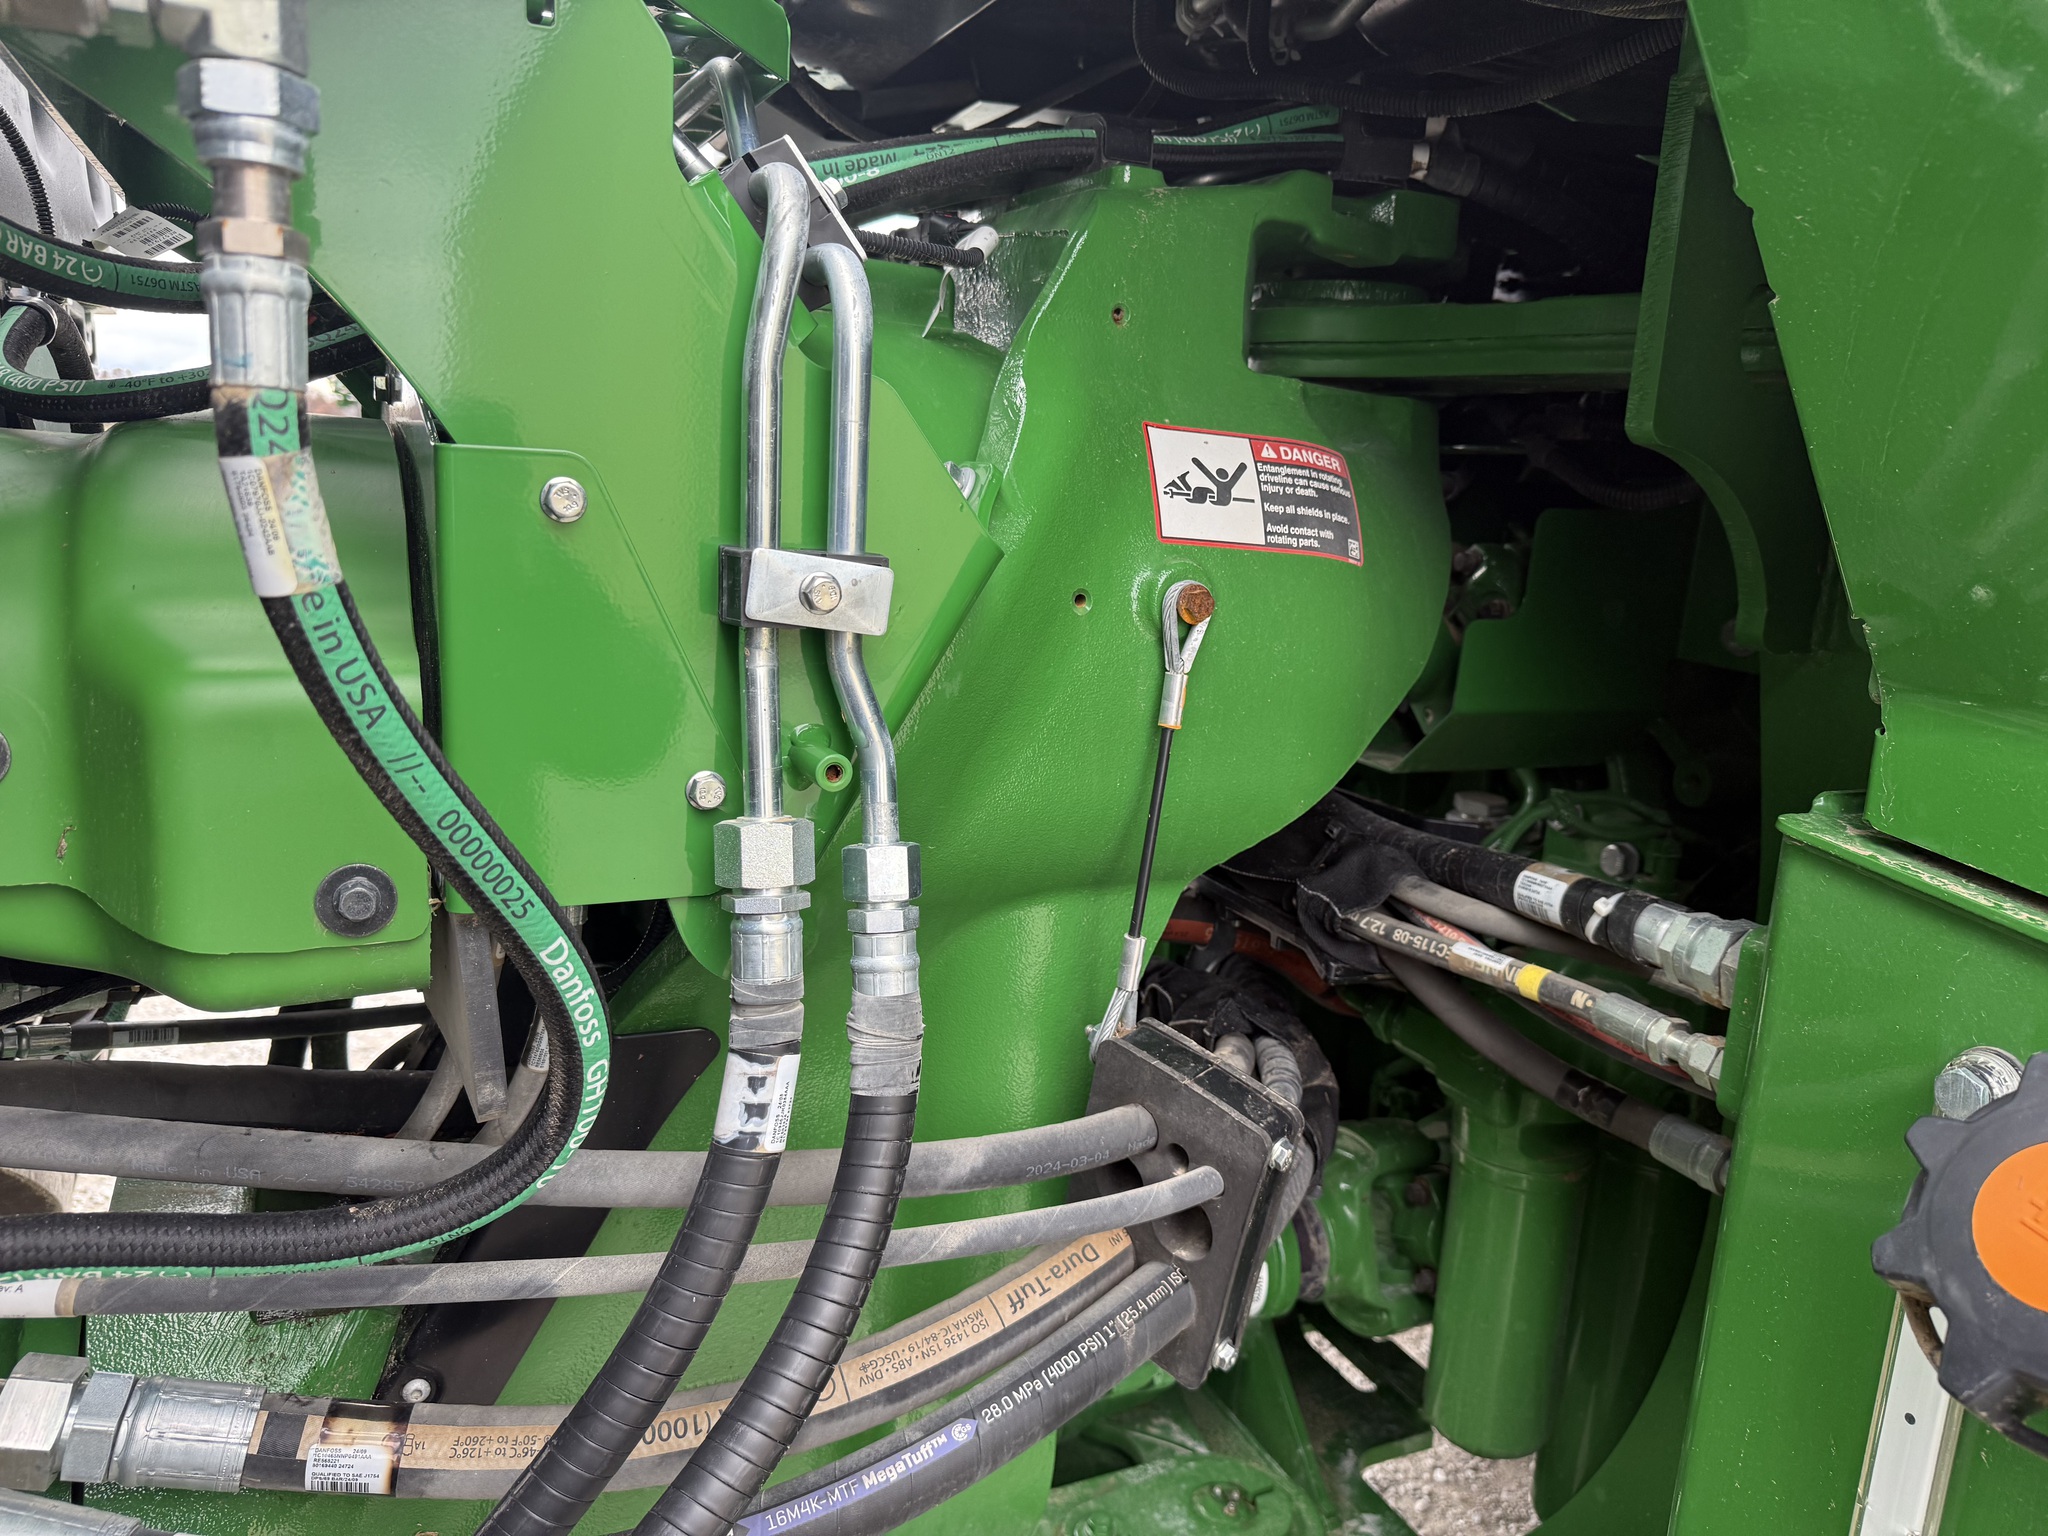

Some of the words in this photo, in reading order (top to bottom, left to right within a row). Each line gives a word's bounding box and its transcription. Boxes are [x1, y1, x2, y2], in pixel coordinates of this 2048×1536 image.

[822, 163, 841, 175] in
[845, 152, 897, 171] Made
[5, 230, 48, 266] BAR
[53, 250, 78, 276] 24
[130, 274, 166, 290] D6751
[42, 380, 86, 393] PSI)
[160, 376, 174, 384] to
[1279, 446, 1341, 472] DANGER
[1257, 463, 1310, 477] Entanglement
[1310, 469, 1318, 478] in
[1319, 472, 1343, 488] rotating
[1259, 473, 1293, 485] driveline
[1294, 478, 1308, 487] can
[1309, 480, 1330, 491] cause
[1331, 484, 1352, 498] serious
[1261, 483, 1284, 495] injury
[1285, 487, 1294, 495] or
[1295, 486, 1318, 498] death.
[1264, 502, 1286, 515] Keep
[1286, 505, 1295, 514] all
[1297, 506, 1323, 519] shields
[1324, 510, 1331, 520] in
[1332, 513, 1350, 525] place.
[1266, 523, 1288, 534] Avoid
[1290, 526, 1318, 537] contact
[1319, 529, 1334, 540] with
[1267, 535, 1297, 547] rotating
[1299, 538, 1321, 548] parts.
[313, 616, 343, 655] in
[335, 656, 387, 730] USA
[437, 809, 536, 920] 00000025
[1359, 916, 1386, 935] 12.7
[539, 936, 602, 1048] Danfoss
[132, 1159, 179, 1175] Made
[195, 1165, 212, 1178] in
[225, 1166, 262, 1181] USA
[1026, 1149, 1110, 1178] 2024-03-04
[1006, 1241, 1100, 1315] Dura-Tuff
[952, 1307, 985, 1331] MSHA
[970, 1318, 990, 1334] ISO
[907, 1321, 952, 1353] IC-84/19
[941, 1325, 972, 1350] 1436
[921, 1340, 942, 1359] 1SN
[869, 1350, 902, 1371] USCG
[893, 1356, 913, 1374] ABS
[858, 1370, 884, 1387] DNV
[497, 1435, 509, 1446] to
[766, 1479, 859, 1532] 16M4K-MTF
[981, 1394, 1014, 1424] 28.0
[1013, 1377, 1045, 1406] MPa
[1077, 1330, 1109, 1359] PSI)
[414, 1440, 426, 1450] 1A
[453, 1435, 494, 1448] +260°F
[449, 1446, 492, 1459] +126°C
[495, 1446, 508, 1458] to
